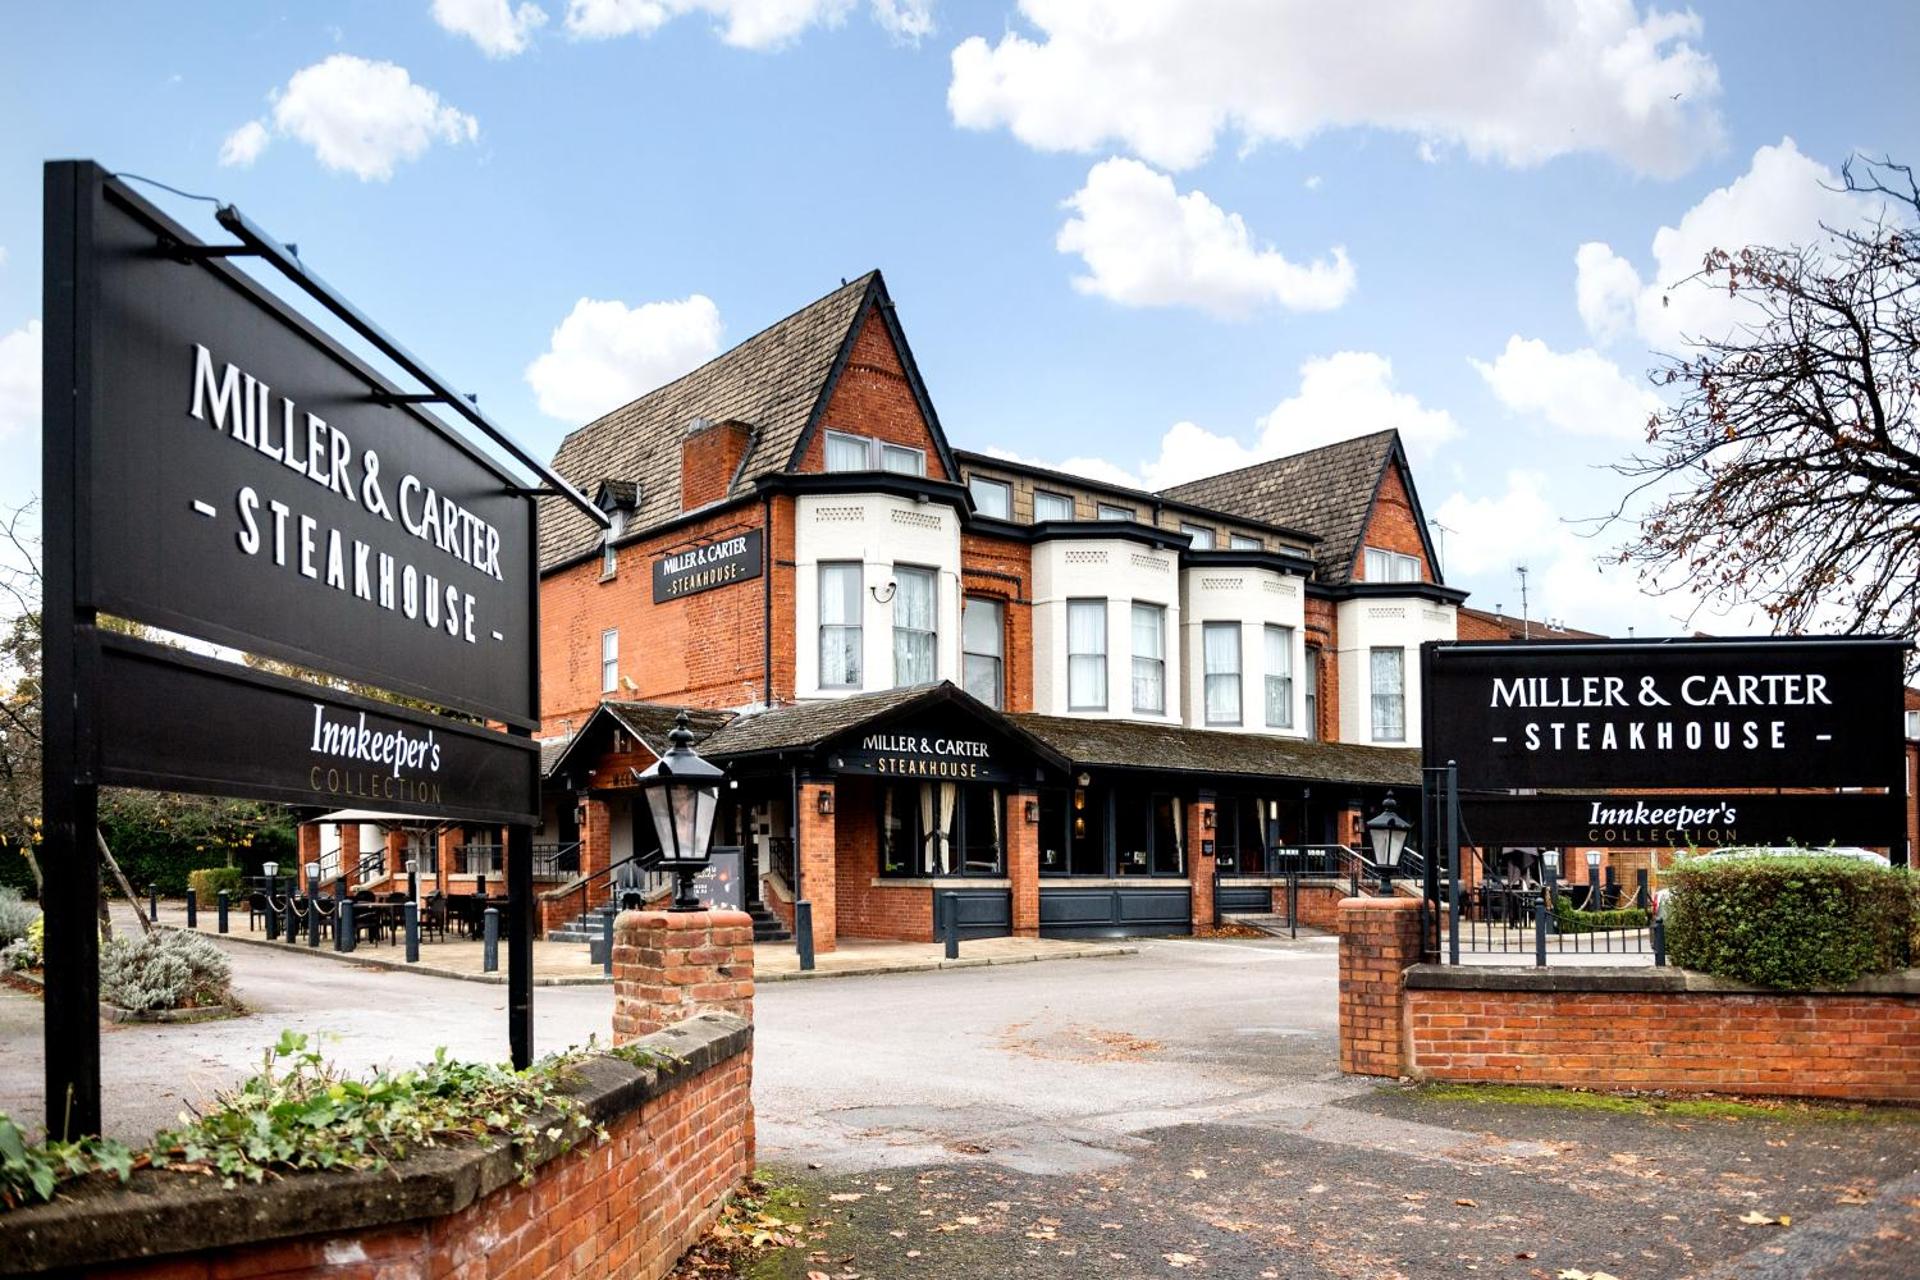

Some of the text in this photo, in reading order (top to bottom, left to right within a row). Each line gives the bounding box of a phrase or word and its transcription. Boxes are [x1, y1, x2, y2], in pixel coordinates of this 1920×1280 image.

[189, 342, 504, 581] MILLER & CARTER
[237, 486, 476, 644] STEAKHOUSE
[663, 537, 747, 576] MILLER & CARTER
[672, 563, 737, 595] STEAKHOUSE
[1490, 674, 1833, 708] MILLER & CARTER
[310, 703, 441, 778] Innkeeper's
[863, 734, 990, 758] MILLER & CARTER
[1525, 720, 1786, 750] STEAKHOUSE
[878, 757, 977, 778] STEAKHOUSE
[310, 766, 441, 804] COLLECTION
[1588, 801, 1737, 830] Innkeeper's
[1588, 828, 1737, 842] COLLECTION
